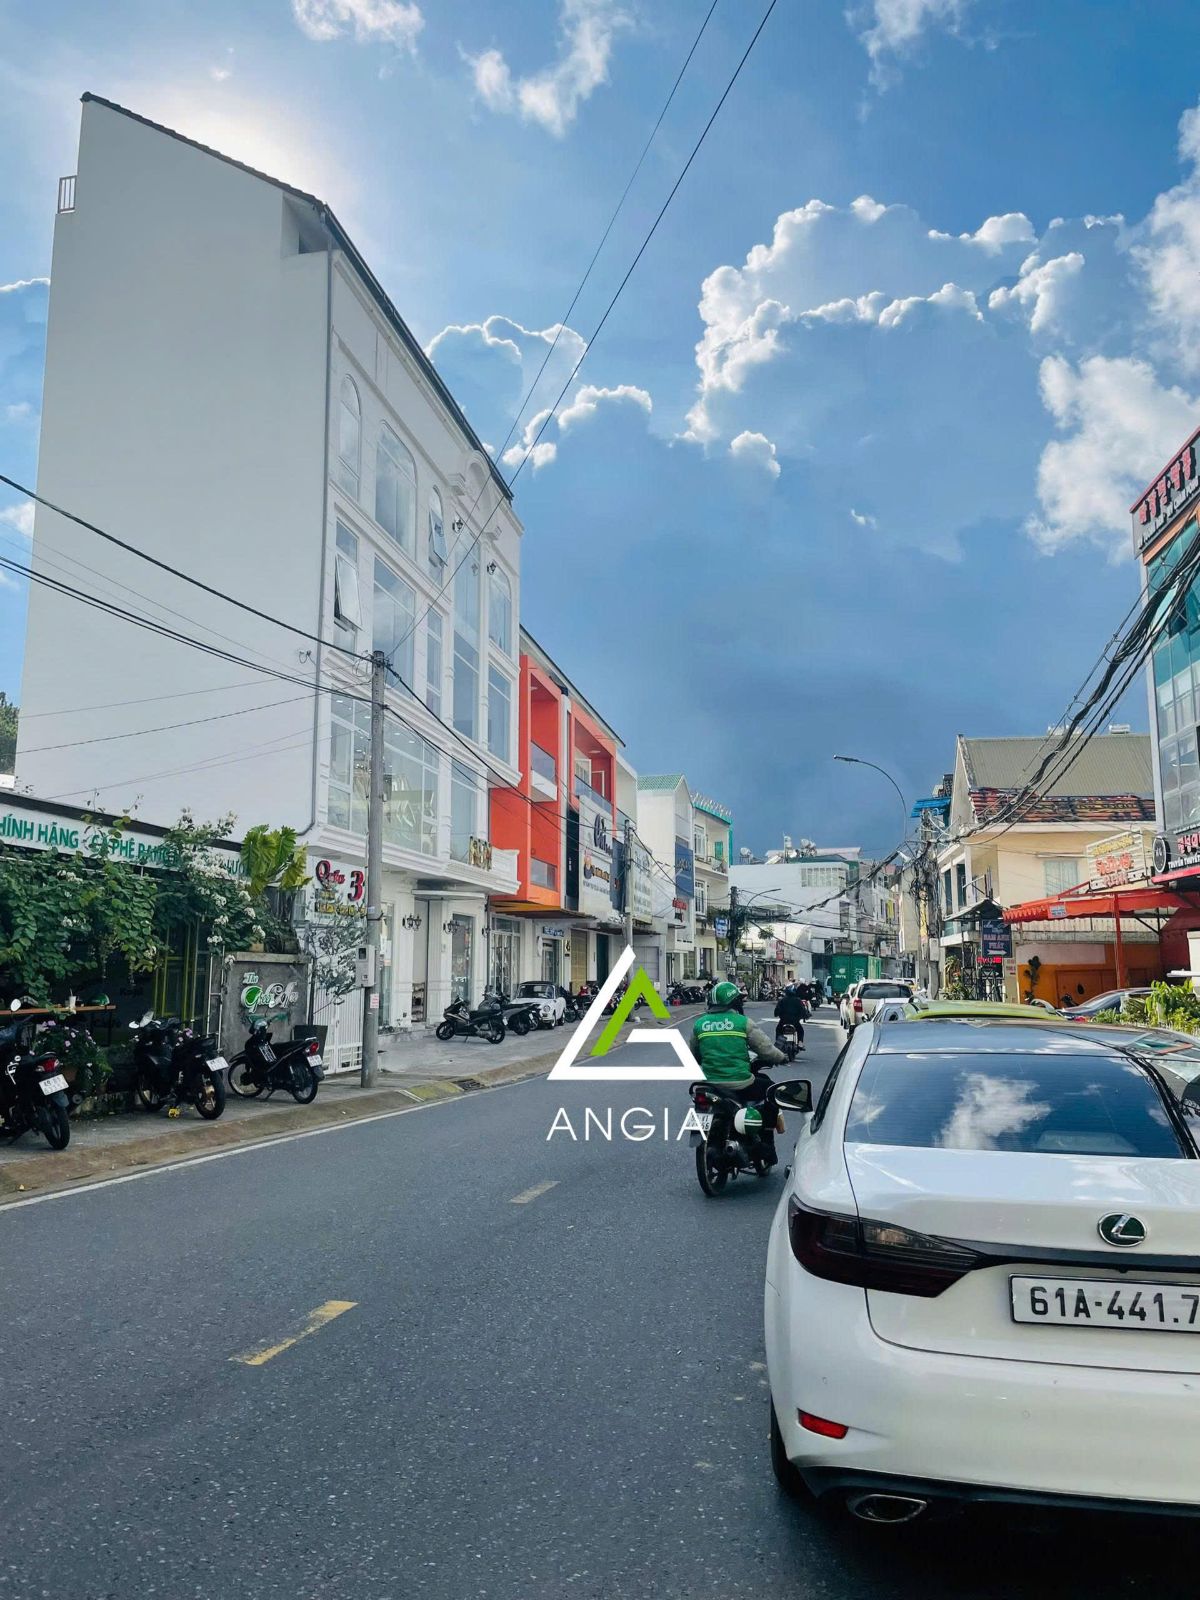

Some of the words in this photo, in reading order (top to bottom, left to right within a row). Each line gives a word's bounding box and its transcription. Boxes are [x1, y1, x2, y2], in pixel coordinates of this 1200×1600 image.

[112, 837, 135, 860] PHÊ
[347, 870, 364, 902] 3
[701, 1018, 735, 1032] Grab
[1030, 1286, 1200, 1324] 61A-441.7
